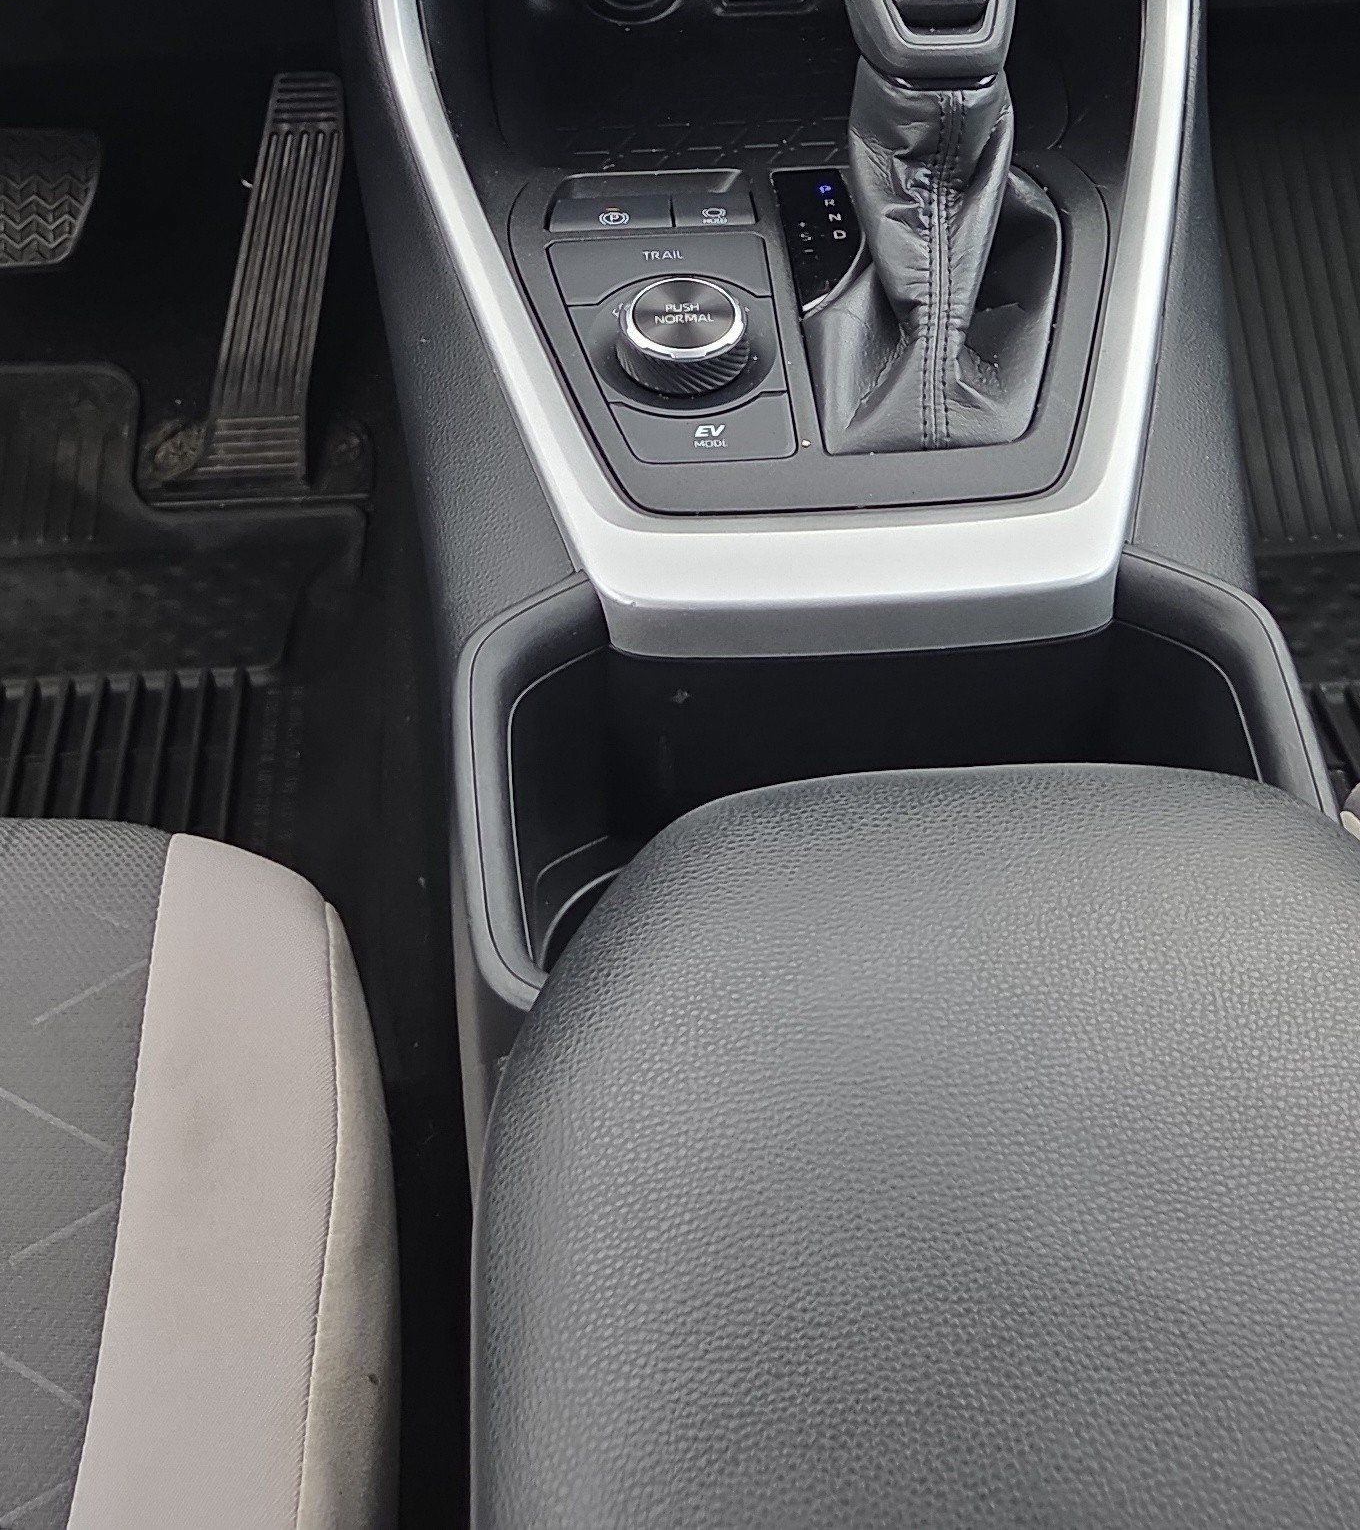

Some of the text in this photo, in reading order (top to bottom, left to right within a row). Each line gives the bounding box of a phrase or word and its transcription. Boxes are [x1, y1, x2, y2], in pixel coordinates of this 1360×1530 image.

[819, 185, 832, 194] P
[824, 198, 836, 207] R
[828, 212, 842, 222] N
[833, 230, 847, 240] D
[642, 250, 684, 261] TRAIL
[665, 302, 700, 313] PUSH
[654, 313, 715, 325] NORMAL
[694, 424, 726, 438] EV
